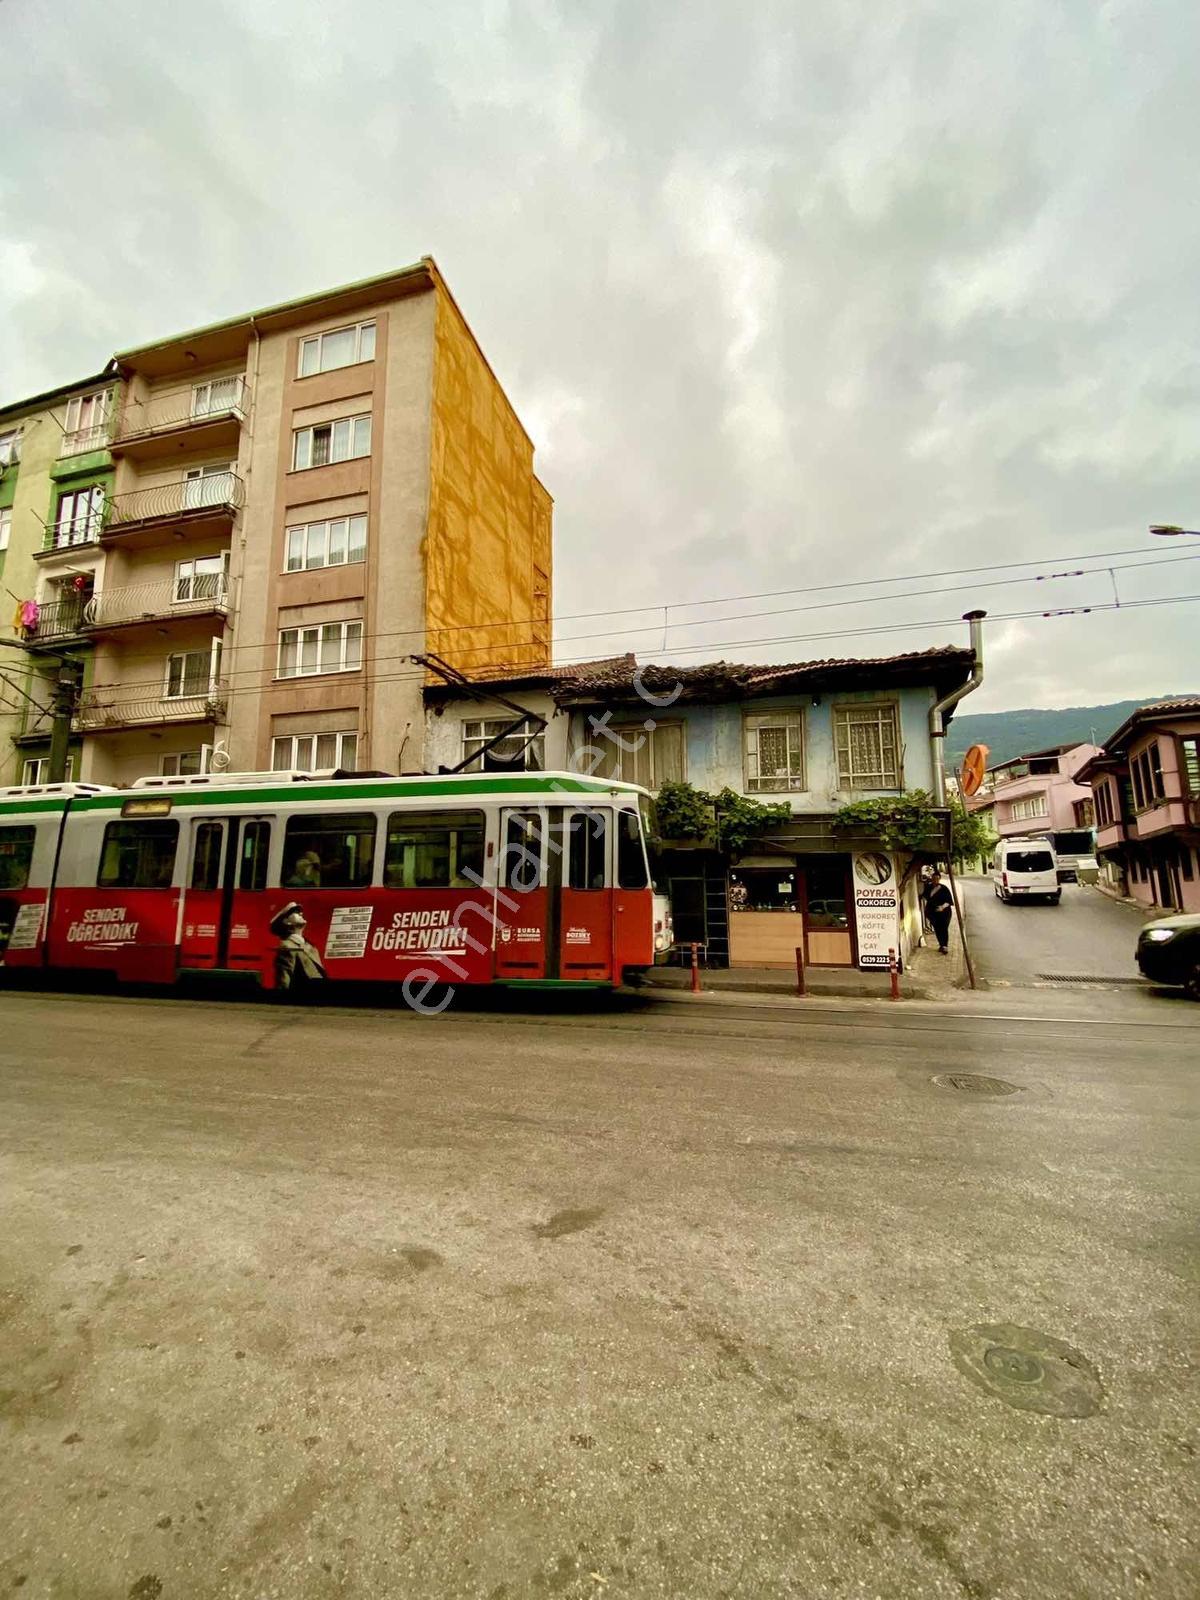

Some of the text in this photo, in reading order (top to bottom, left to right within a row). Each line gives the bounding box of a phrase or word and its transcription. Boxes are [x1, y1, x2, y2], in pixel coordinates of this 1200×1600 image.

[856, 889, 895, 897] POYRAZ
[858, 899, 895, 907] KOKOREÇ
[83, 907, 127, 923] SENDEN
[392, 910, 450, 928] SENDEN
[66, 921, 139, 942] ÖĞRENDİK!
[371, 927, 468, 951] ÖĞRENDİK!
[863, 932, 881, 940] TOST
